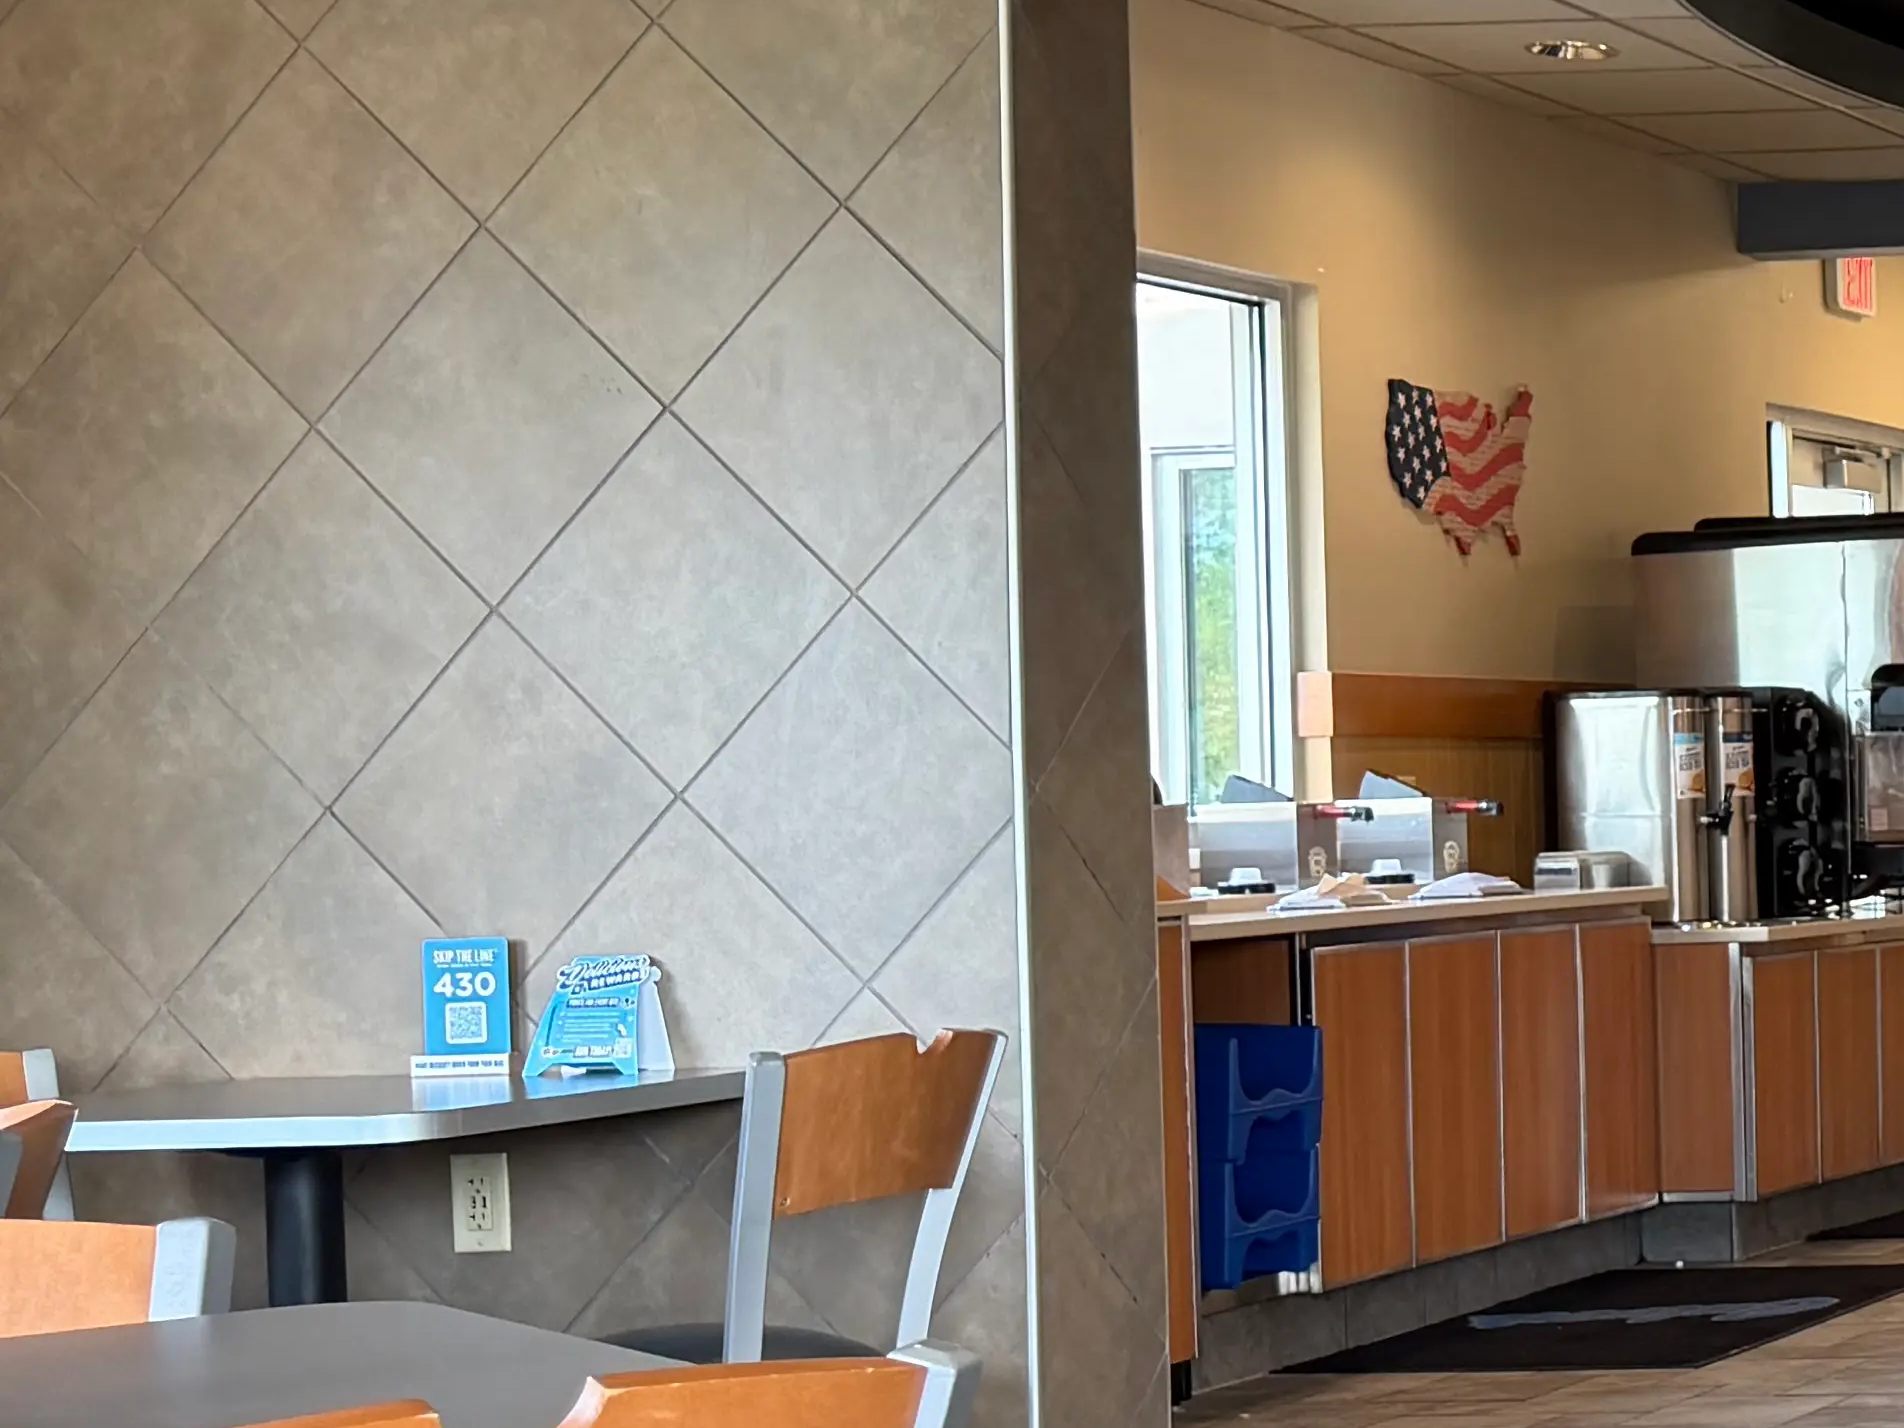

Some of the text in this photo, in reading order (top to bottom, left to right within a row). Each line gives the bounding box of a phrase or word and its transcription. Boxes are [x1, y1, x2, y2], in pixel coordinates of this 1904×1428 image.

[433, 948, 494, 964] SKIP THE LINE
[433, 971, 496, 997] 430
[559, 956, 648, 989] Delicious
